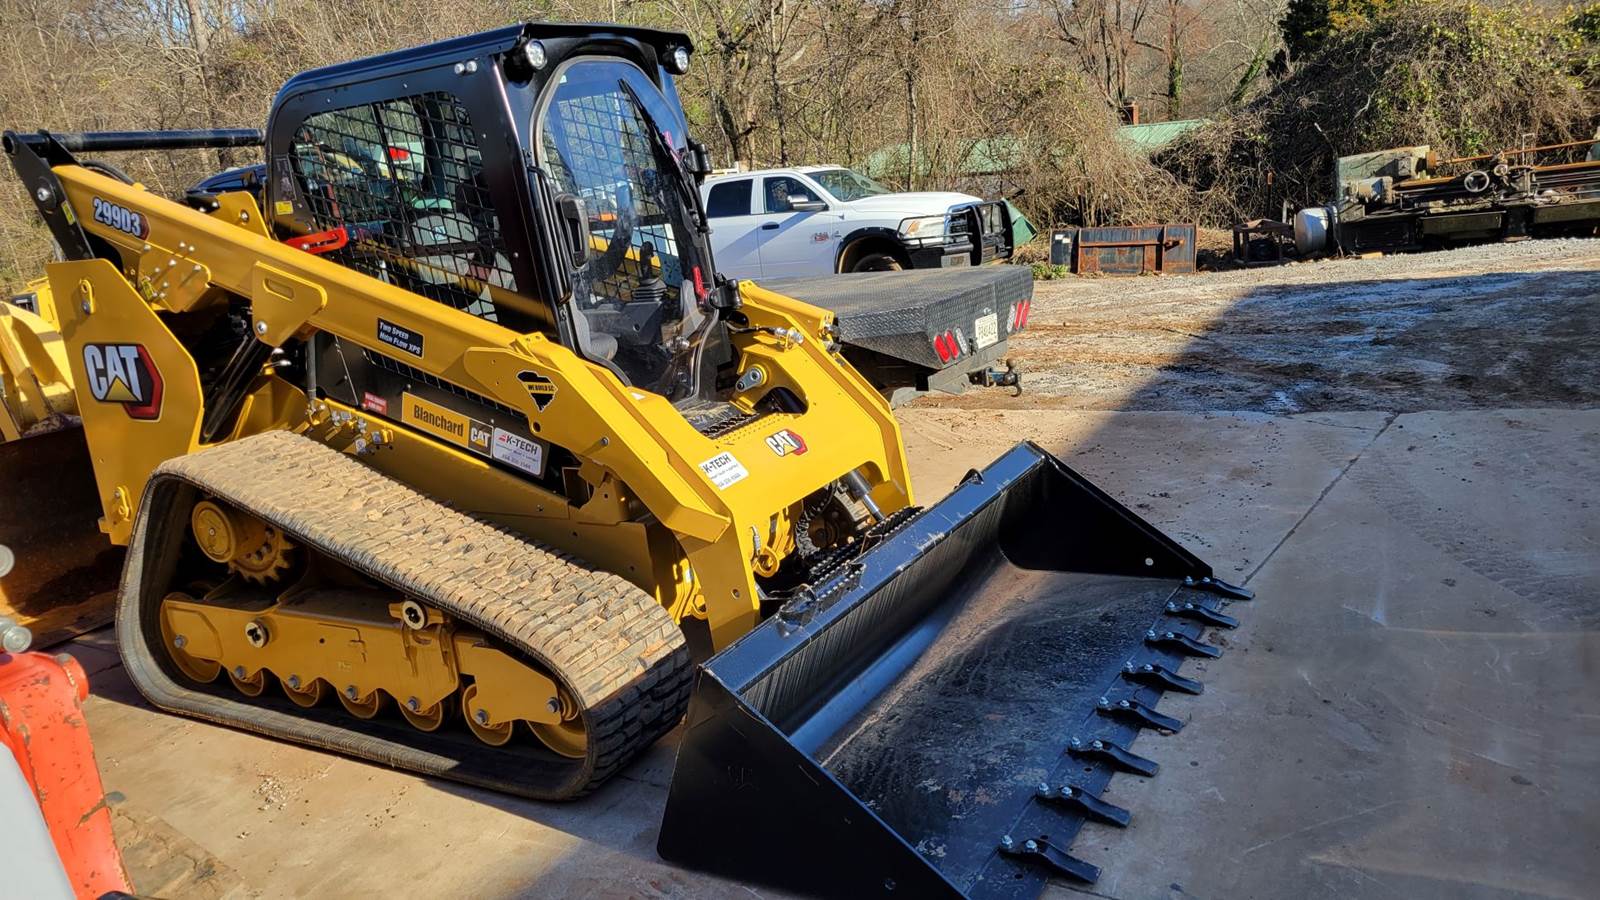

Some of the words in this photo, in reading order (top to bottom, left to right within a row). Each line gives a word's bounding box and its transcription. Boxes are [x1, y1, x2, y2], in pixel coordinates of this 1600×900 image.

[93, 198, 141, 237] 299D3
[409, 343, 421, 354] XPS
[83, 345, 144, 402] CAT
[413, 404, 465, 437] Blanchard
[470, 427, 491, 448] CAT
[506, 434, 538, 456] K-TECH
[764, 430, 800, 457] CAT
[702, 453, 732, 474] K-TECH
